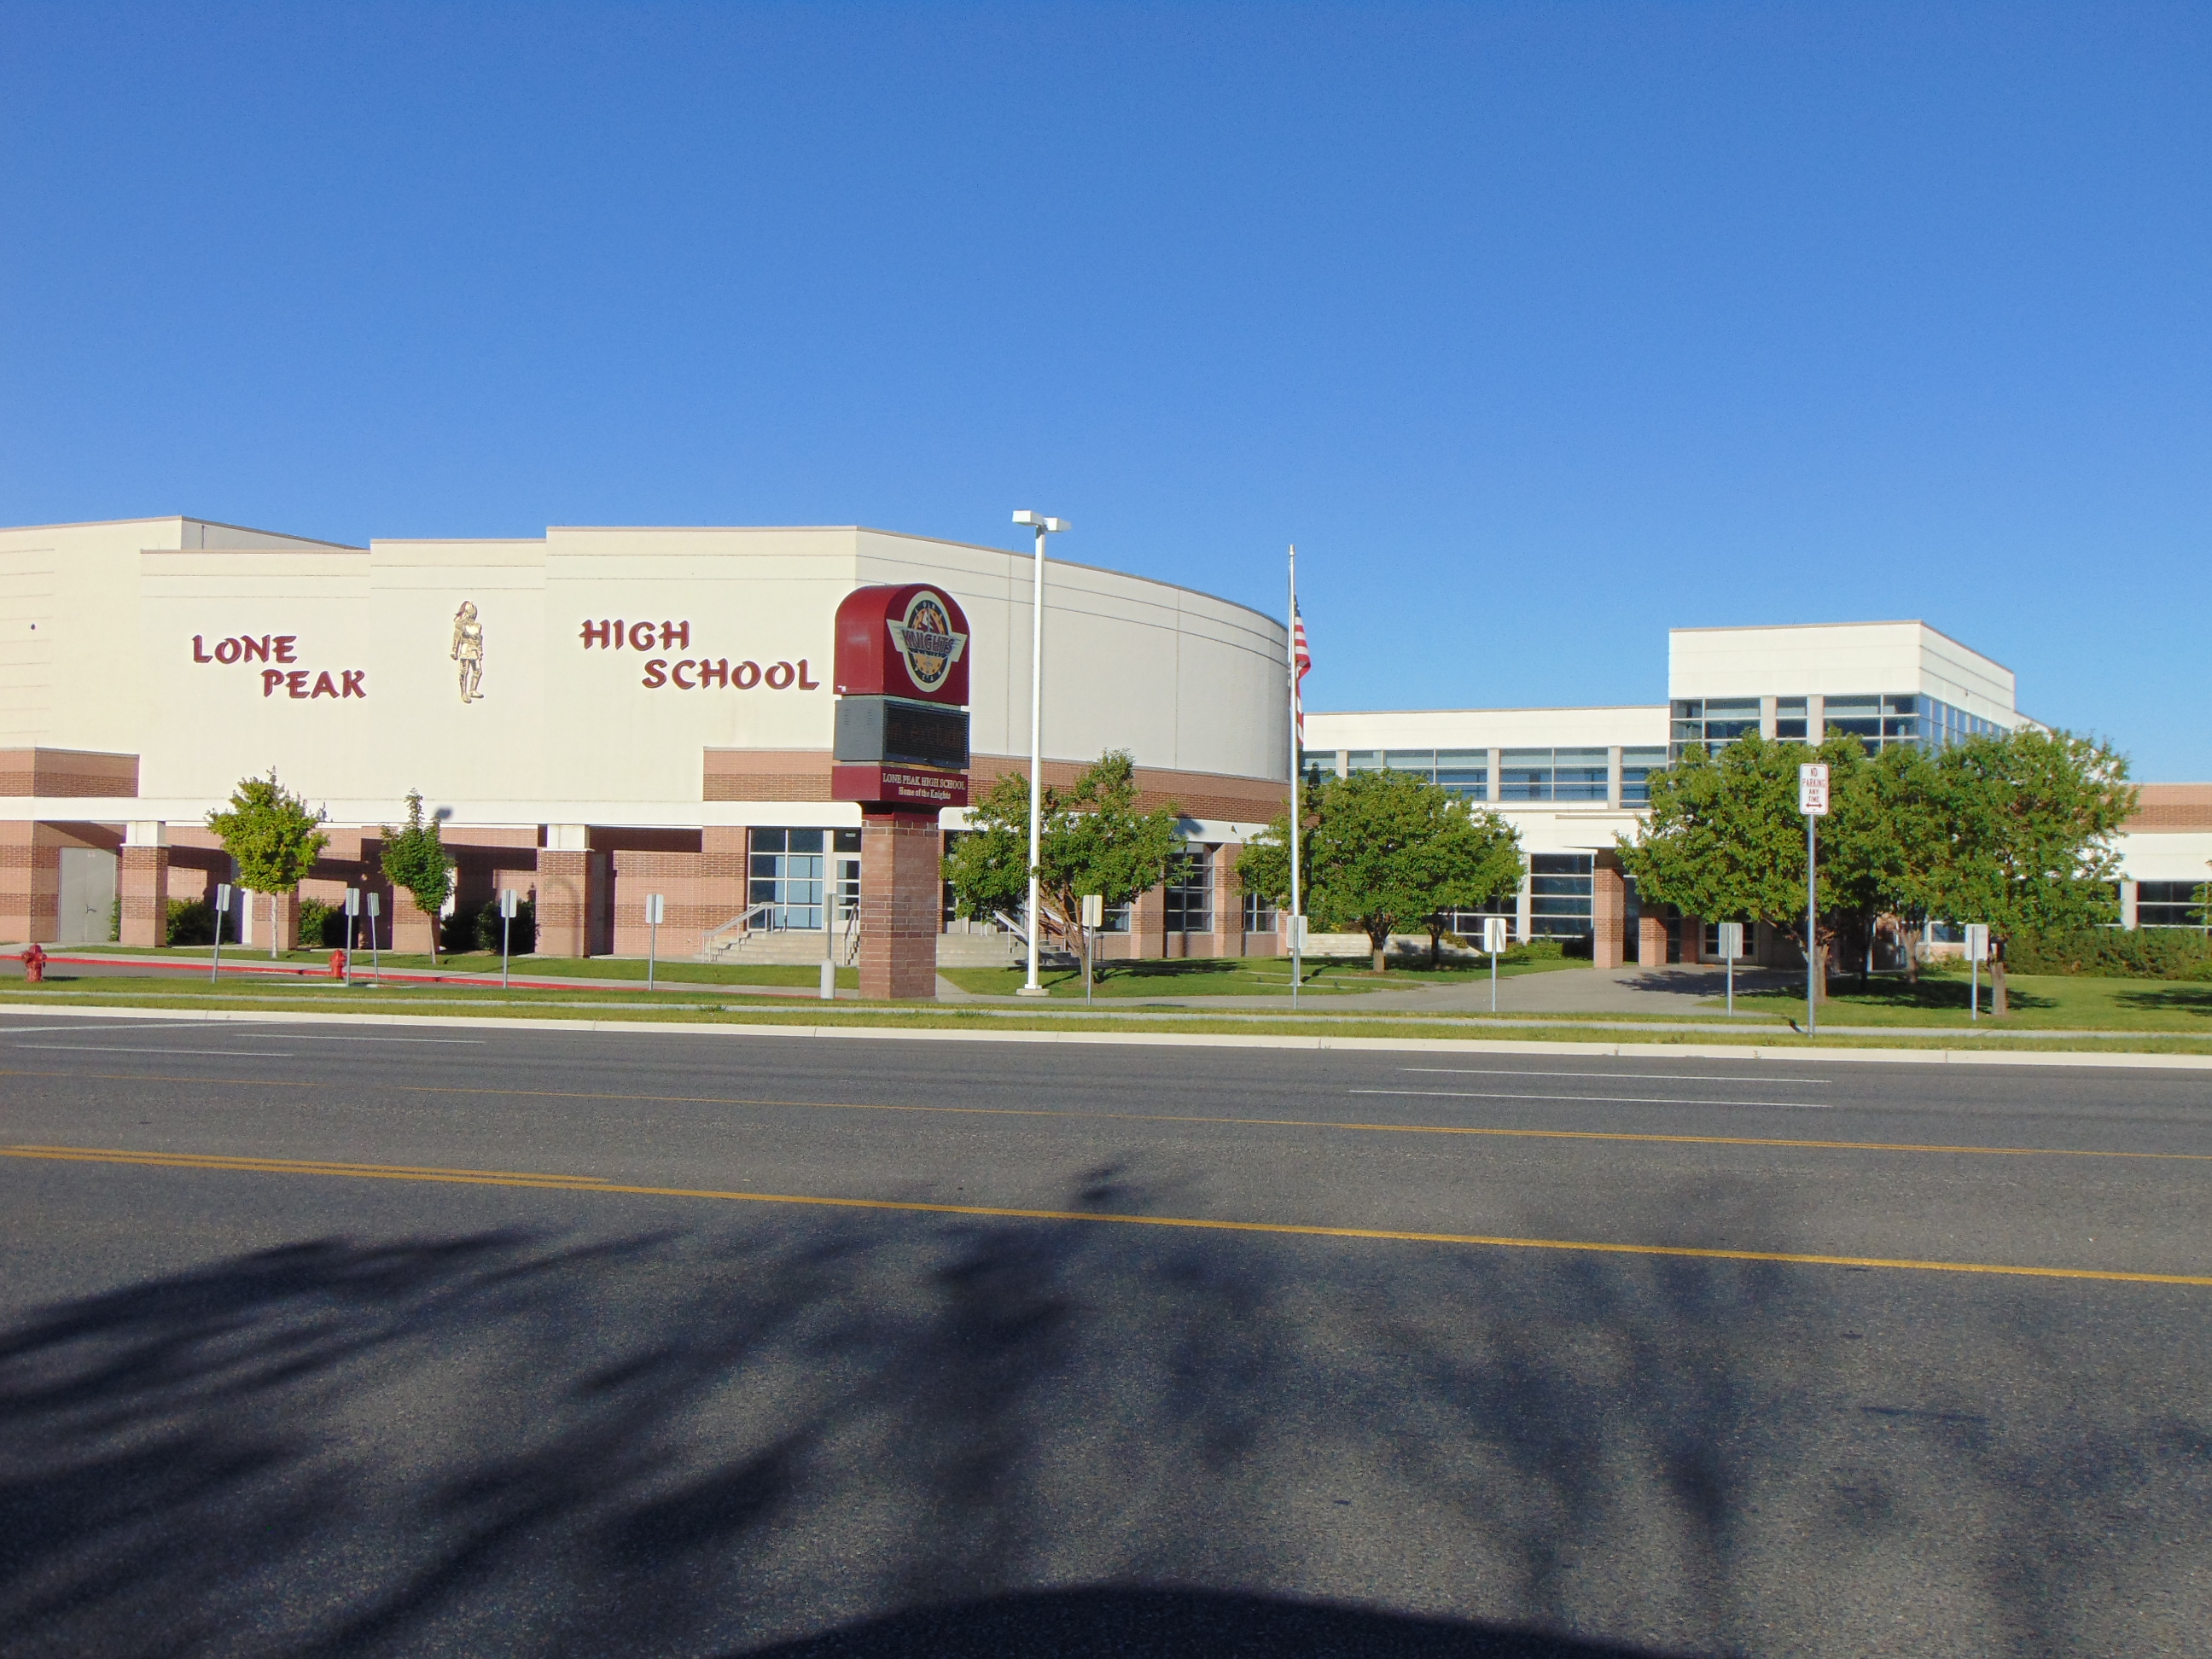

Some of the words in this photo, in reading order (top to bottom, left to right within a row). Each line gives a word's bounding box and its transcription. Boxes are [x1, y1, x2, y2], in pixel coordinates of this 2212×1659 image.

[579, 619, 690, 651] HIGH
[901, 628, 955, 655] KNIGHTS
[192, 634, 297, 664] LONE
[260, 669, 367, 699] PEAK
[642, 658, 819, 690] SCHOOL
[882, 773, 902, 783] LONE
[903, 775, 920, 785] PEAK
[921, 777, 939, 787] HIGH
[940, 779, 966, 790] SCHOOL
[1802, 778, 1825, 788] PARKING
[1810, 767, 1818, 777] NO
[899, 787, 914, 795] Home
[930, 789, 951, 800] Knights
